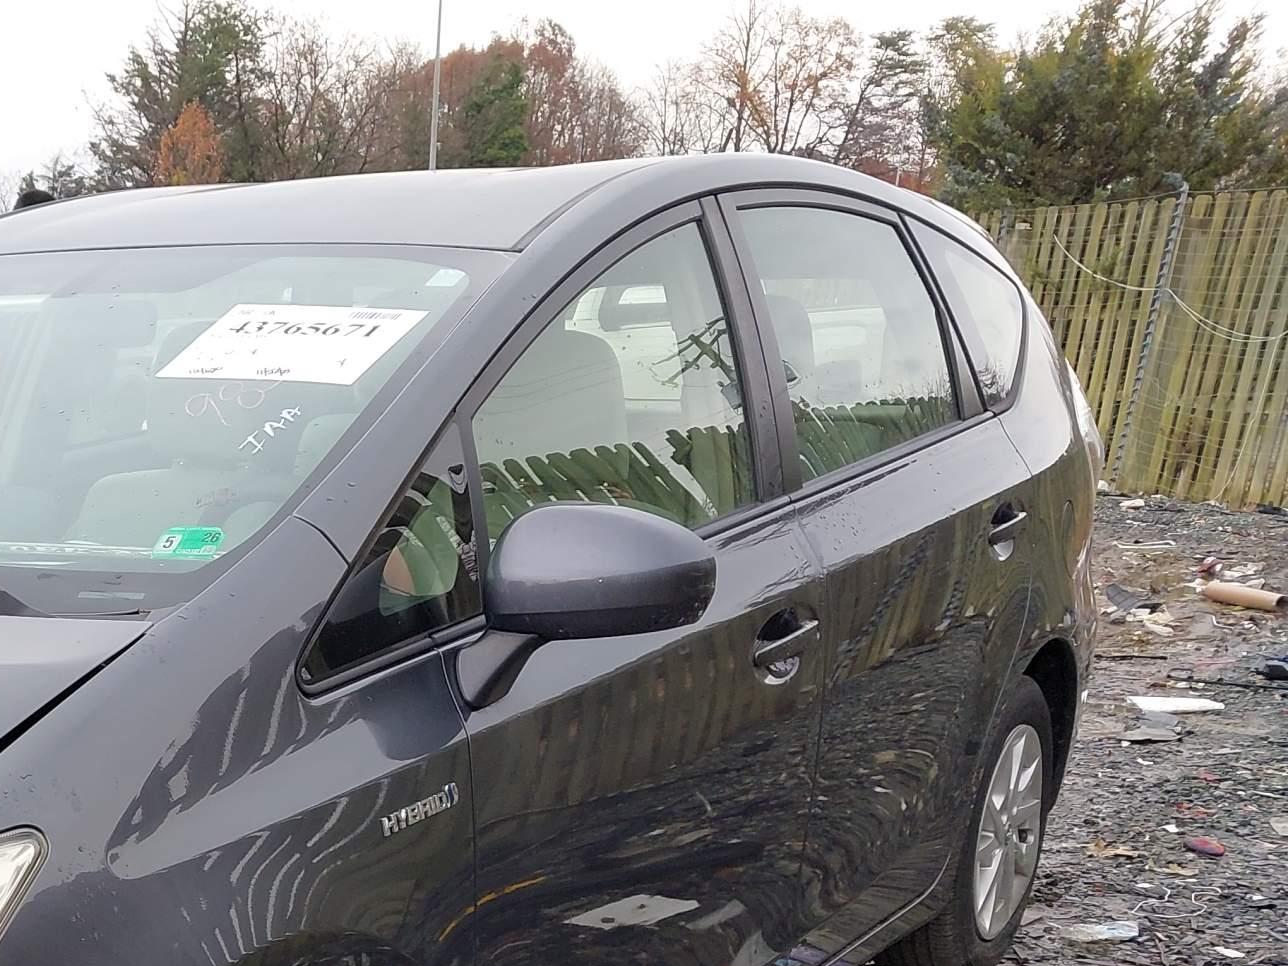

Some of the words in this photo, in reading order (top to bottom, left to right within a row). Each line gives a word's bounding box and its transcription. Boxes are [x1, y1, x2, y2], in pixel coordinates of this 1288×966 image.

[228, 320, 381, 338] 43765671
[162, 535, 177, 549] 5
[201, 532, 222, 543] 26
[379, 790, 448, 838] HYBRID
